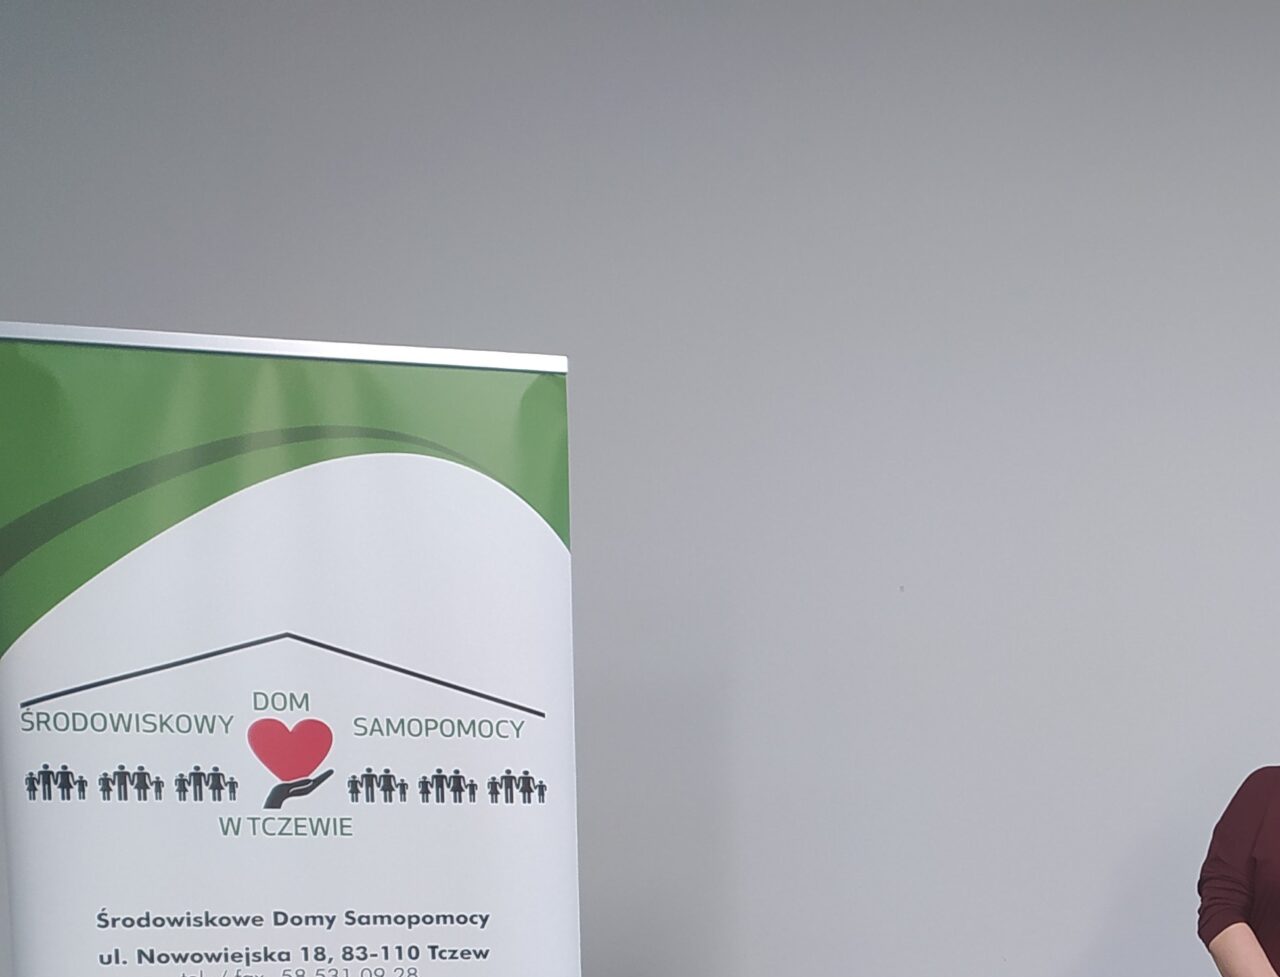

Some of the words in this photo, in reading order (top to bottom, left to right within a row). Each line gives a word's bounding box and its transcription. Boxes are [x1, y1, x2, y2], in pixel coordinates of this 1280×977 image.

[253, 692, 310, 712] DOM
[21, 707, 234, 735] ŚRODOWISKOWY
[353, 717, 525, 739] SAMOPOMOCY
[219, 817, 242, 836] W
[247, 817, 353, 836] TCZEWIE
[97, 907, 264, 928] Środowiskowe
[273, 911, 337, 930] Domy
[344, 910, 490, 929] Samopomocy
[99, 948, 128, 965] ul.
[137, 947, 291, 967] Nowowiejska
[299, 946, 334, 964] 18,
[341, 946, 419, 961] 83-110
[428, 945, 490, 960] Tczew
